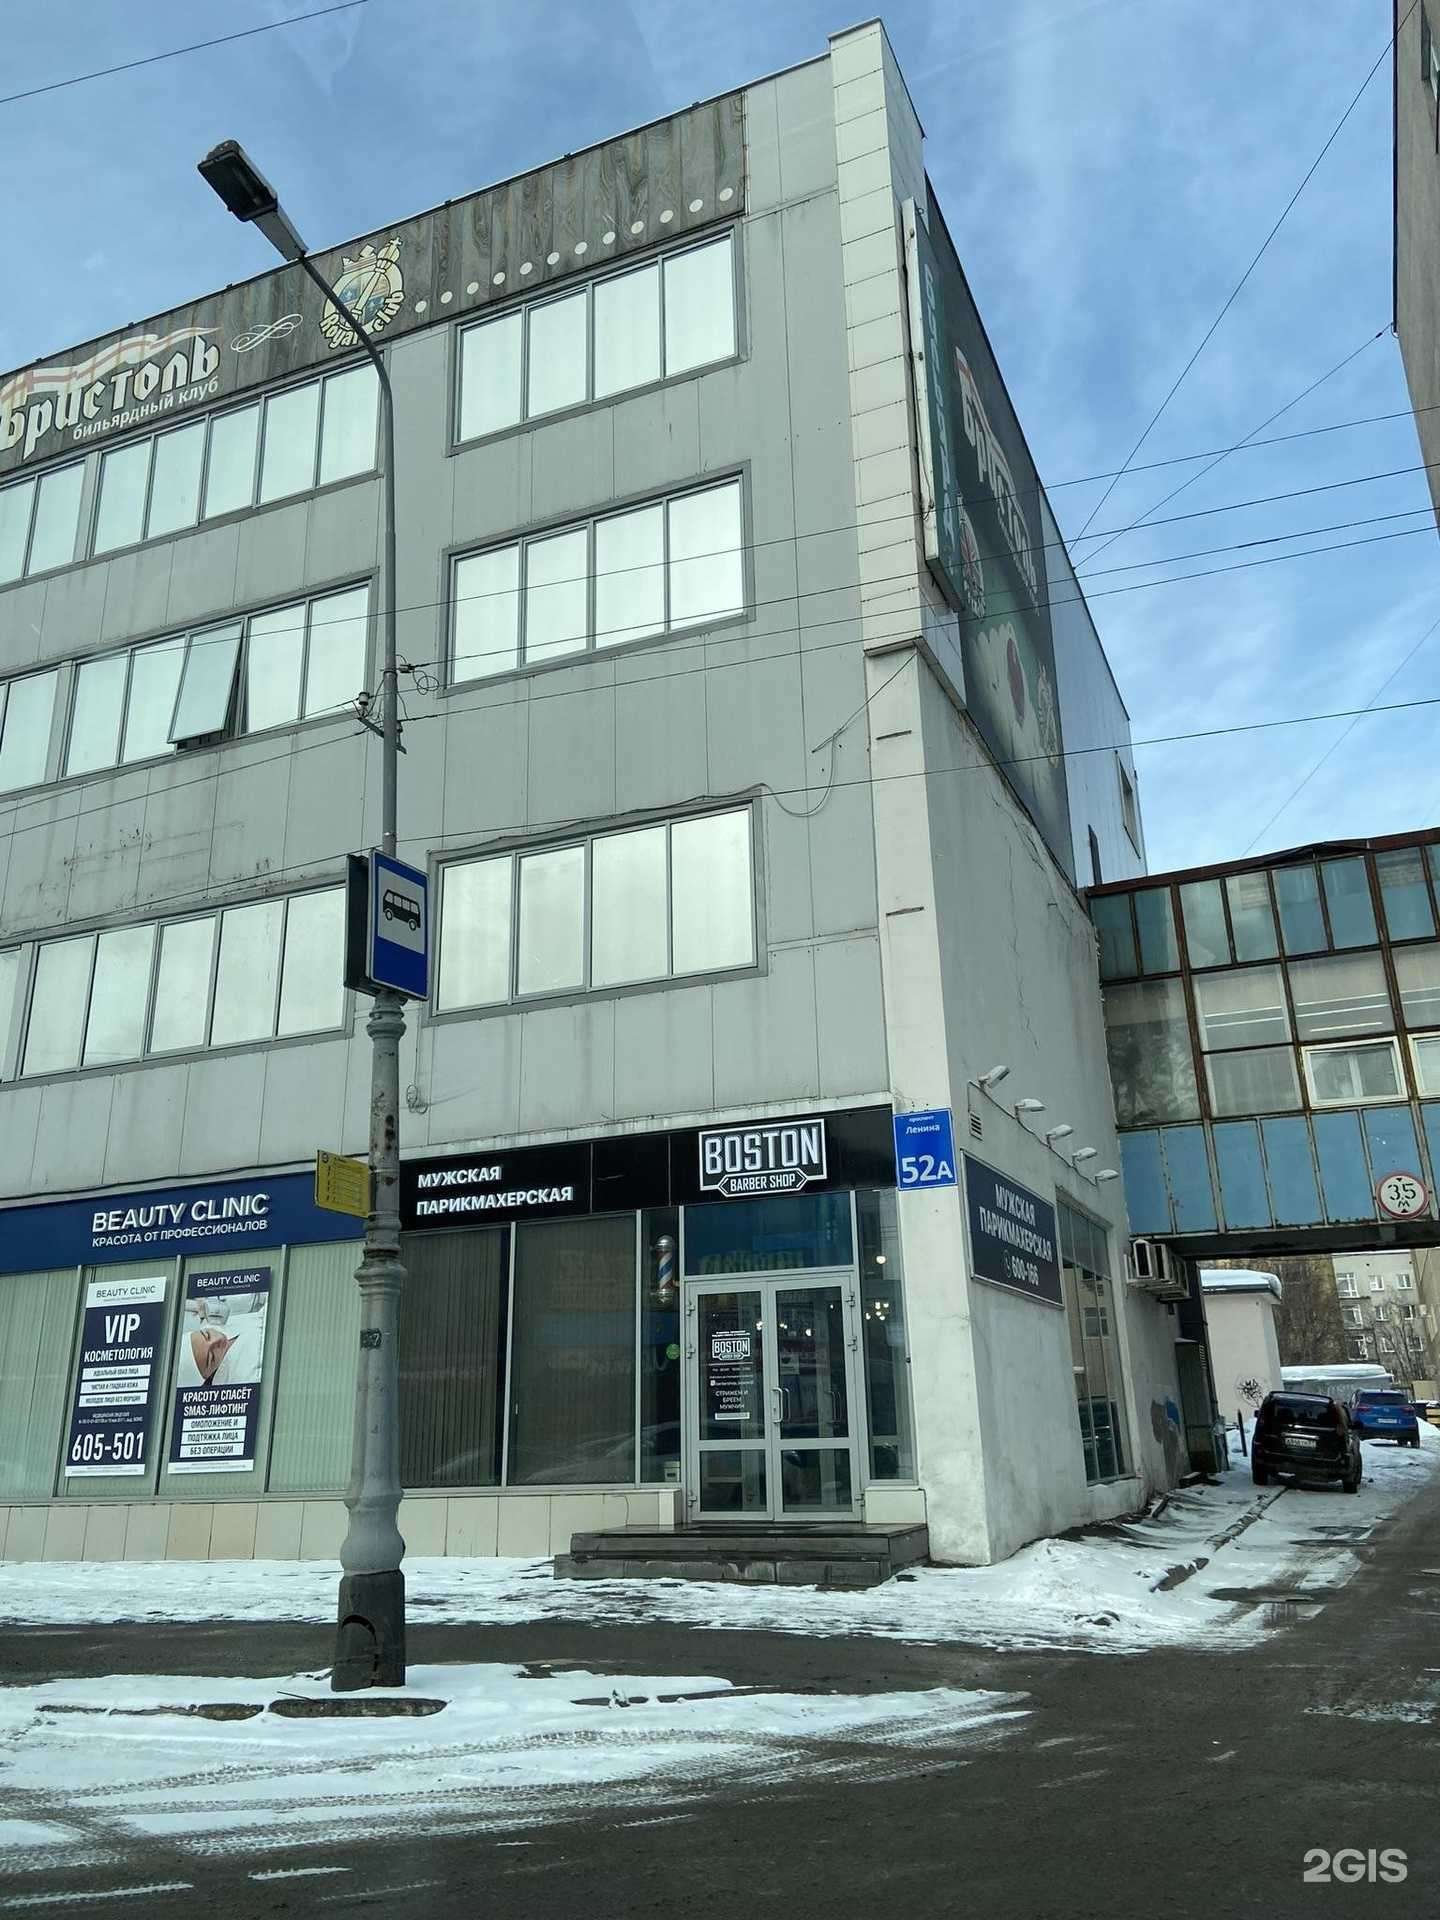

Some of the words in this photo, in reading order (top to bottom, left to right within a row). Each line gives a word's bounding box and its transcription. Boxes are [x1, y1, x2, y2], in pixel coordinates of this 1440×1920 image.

[372, 290, 405, 332] club
[73, 394, 174, 441] бильярдный
[178, 375, 219, 405] клуб
[906, 1124, 940, 1136] Ленина
[705, 1127, 820, 1174] BOSTON
[417, 1166, 502, 1188] МУЖСКАЯ
[730, 1176, 767, 1191] BARBER
[769, 1173, 796, 1188] SHOP
[416, 1186, 574, 1216] ПАРИКМАХЕРСКАЯ
[994, 1183, 1036, 1226] МУЖСКАЯ
[92, 1202, 188, 1233] BEAUTY
[190, 1193, 269, 1222] CLINIC
[92, 1233, 142, 1248] КРАСОТА
[144, 1231, 159, 1243] ОТ
[160, 1219, 268, 1241] ПРОФЕССИОНАЛОВ
[979, 1206, 1053, 1263] ПАРИКМАХЕРСКАЯ
[196, 1276, 231, 1287] BEAUTY
[232, 1273, 260, 1284] CLINIC
[1010, 1255, 1040, 1287] 600-166
[96, 1287, 128, 1298] BEAUTY
[130, 1285, 156, 1295] CLINIC
[105, 1313, 140, 1344] VIP
[84, 1346, 153, 1363] КОСМЕТОЛОГИЯ
[714, 1340, 748, 1354] BOSTON
[182, 1390, 220, 1403] КРАСОТУ
[220, 1386, 252, 1401] СПАСЁТ
[183, 1402, 249, 1417] SMAS-ЛИФТИНГ
[190, 1419, 232, 1429] ОМОЛОЖЕНИЕ
[233, 1418, 239, 1426] И
[71, 1431, 144, 1462] 605-501
[187, 1433, 221, 1442] ПОДТЯЖКА
[221, 1432, 239, 1441] ЛИЦА
[190, 1446, 201, 1455] БЕЗ
[202, 1445, 234, 1455] ОПЕРАЦИИ
